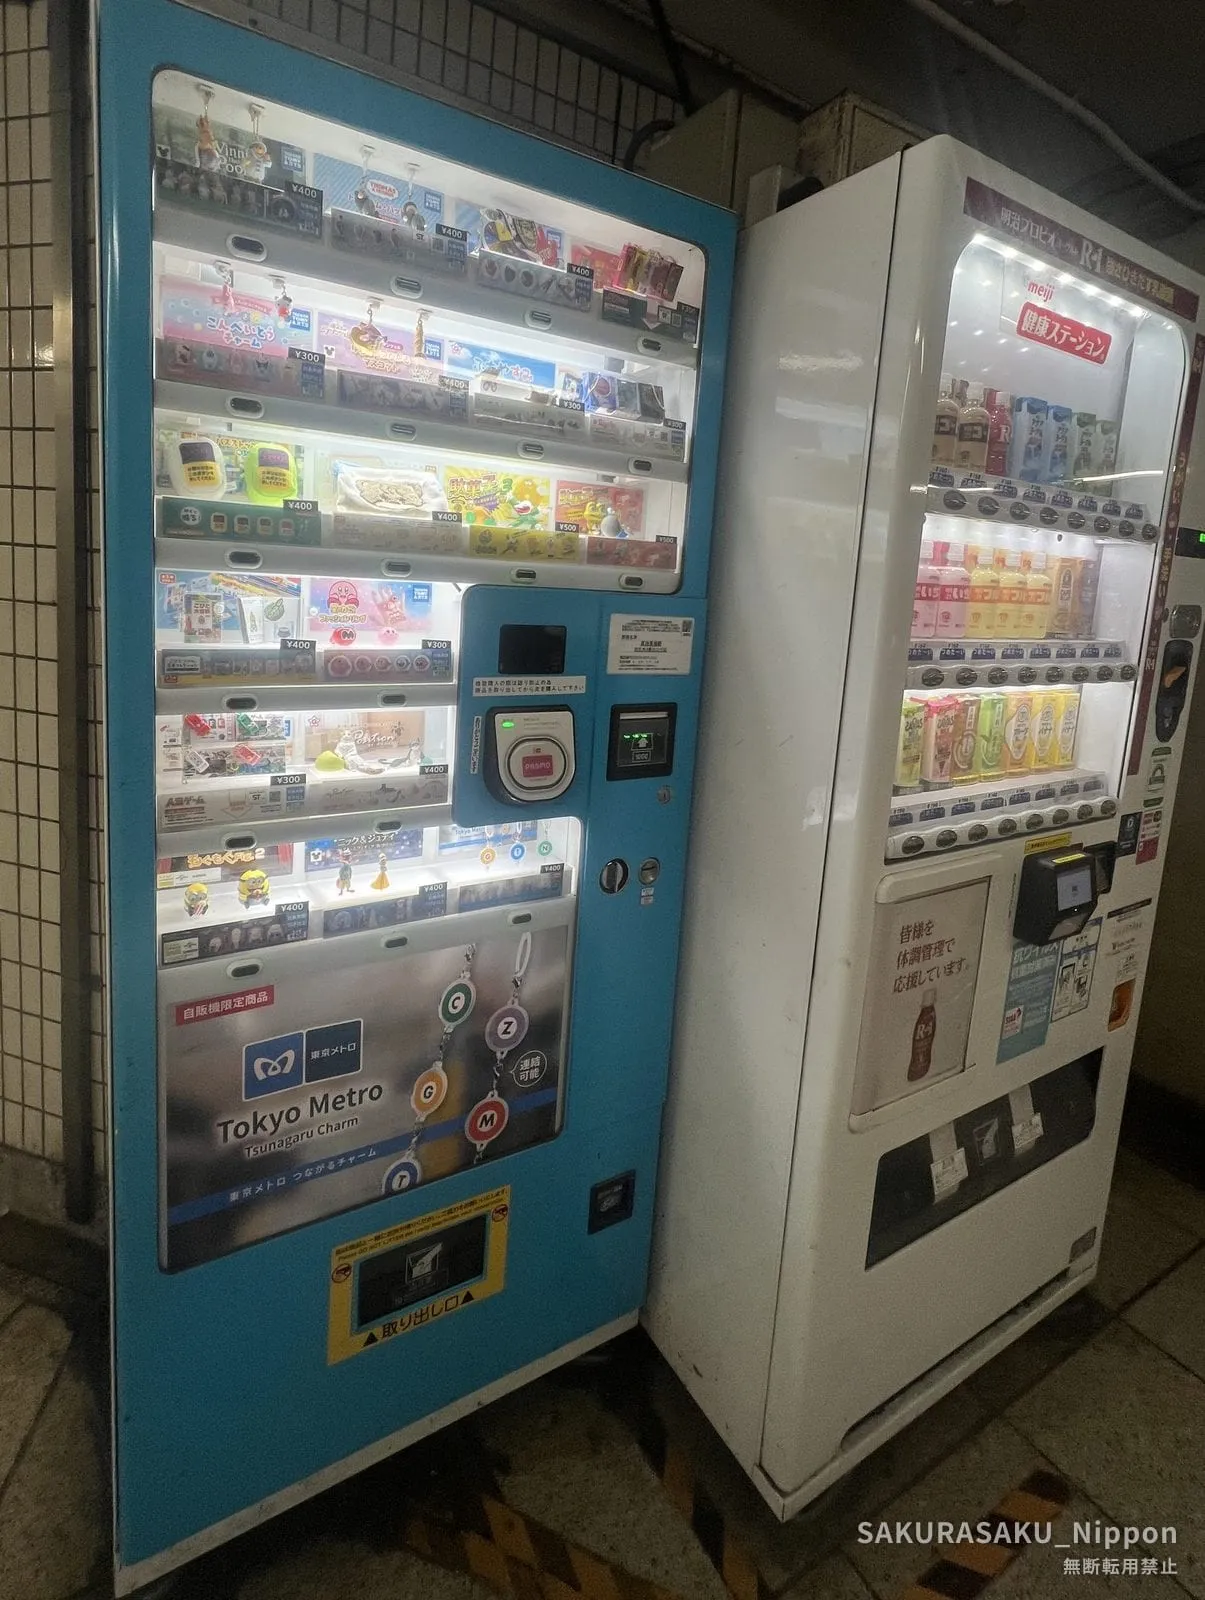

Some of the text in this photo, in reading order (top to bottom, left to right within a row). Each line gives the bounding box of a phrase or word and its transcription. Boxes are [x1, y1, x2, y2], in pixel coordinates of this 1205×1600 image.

[292, 184, 317, 199] ¥400
[441, 225, 463, 239] ¥400
[571, 265, 590, 277] ¥400
[1028, 280, 1055, 302] meiji
[207, 316, 276, 342] こんぺいとう
[1021, 309, 1105, 358] 健康ステーション
[223, 332, 262, 349] チャーム
[294, 350, 320, 363] ¥300
[563, 401, 581, 411] ¥300
[288, 502, 313, 511] ¥400
[437, 514, 458, 522] ¥400
[287, 640, 310, 649] ¥400
[427, 641, 447, 649] ¥300
[525, 762, 551, 770] PASMO
[277, 776, 300, 784] ¥300
[545, 864, 561, 872] ¥400
[424, 883, 444, 892] ¥400
[281, 903, 304, 912] ¥400
[899, 919, 934, 944] 皆様を
[897, 937, 956, 970] 体調管理で
[893, 957, 970, 993] 応援しています。
[184, 991, 268, 1020] 自販機限定商品
[451, 996, 462, 1010] C
[501, 1021, 514, 1035] Z
[311, 1042, 356, 1060] 東京メトロ
[519, 1055, 541, 1071] 連結
[519, 1068, 540, 1082] 可能
[424, 1085, 434, 1098] G
[217, 1084, 383, 1143] Tokyo Metro
[480, 1113, 495, 1128] M
[245, 1116, 358, 1158] Tsunagaru Charm
[229, 1148, 376, 1201] 東京メトロ つながるチャーム
[397, 1174, 407, 1188] T
[381, 1295, 459, 1339] 取り出し口
